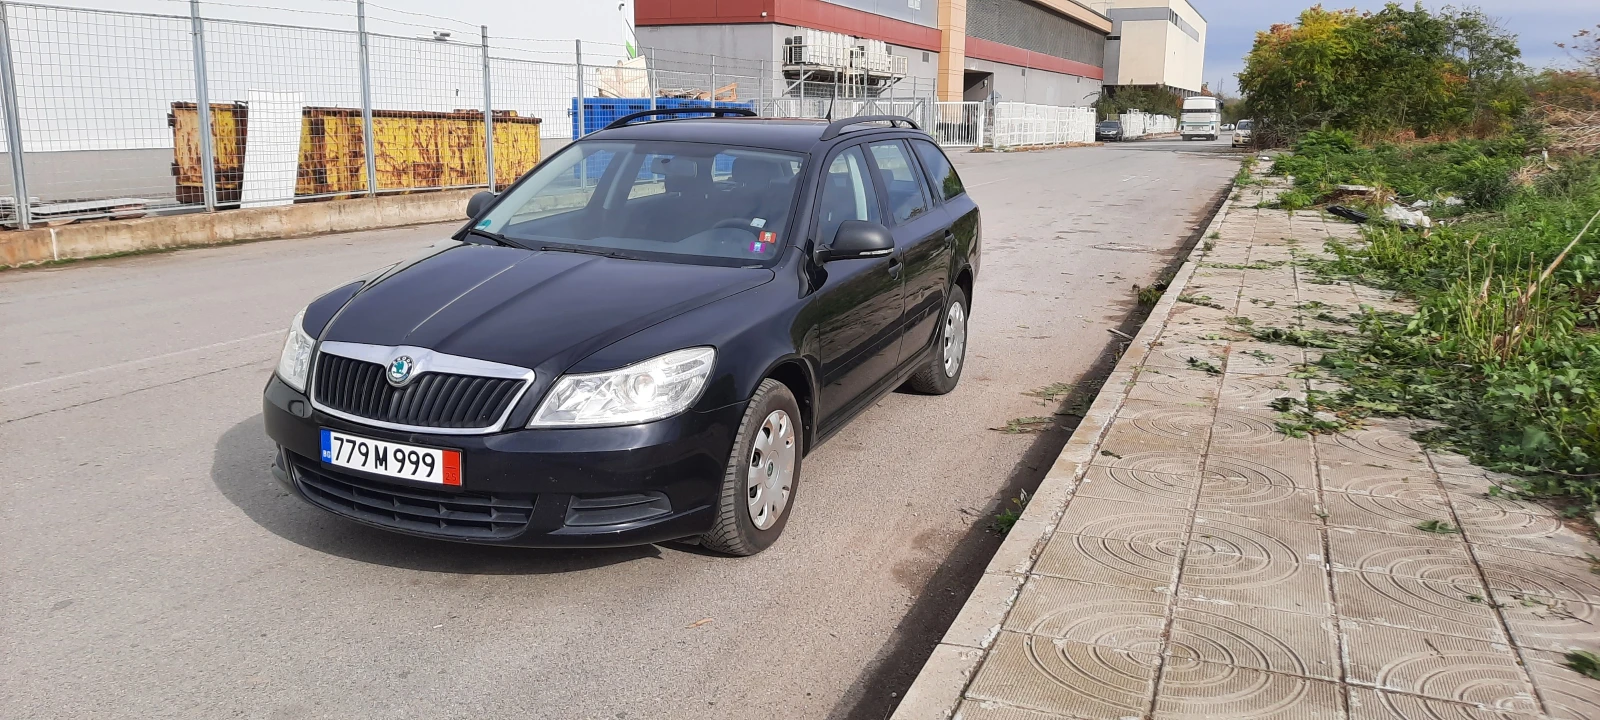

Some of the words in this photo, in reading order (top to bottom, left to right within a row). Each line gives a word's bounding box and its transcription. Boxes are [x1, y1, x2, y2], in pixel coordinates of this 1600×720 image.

[322, 449, 331, 459] BG
[333, 436, 369, 467] 779
[374, 444, 388, 471] M
[393, 448, 435, 478] 999
